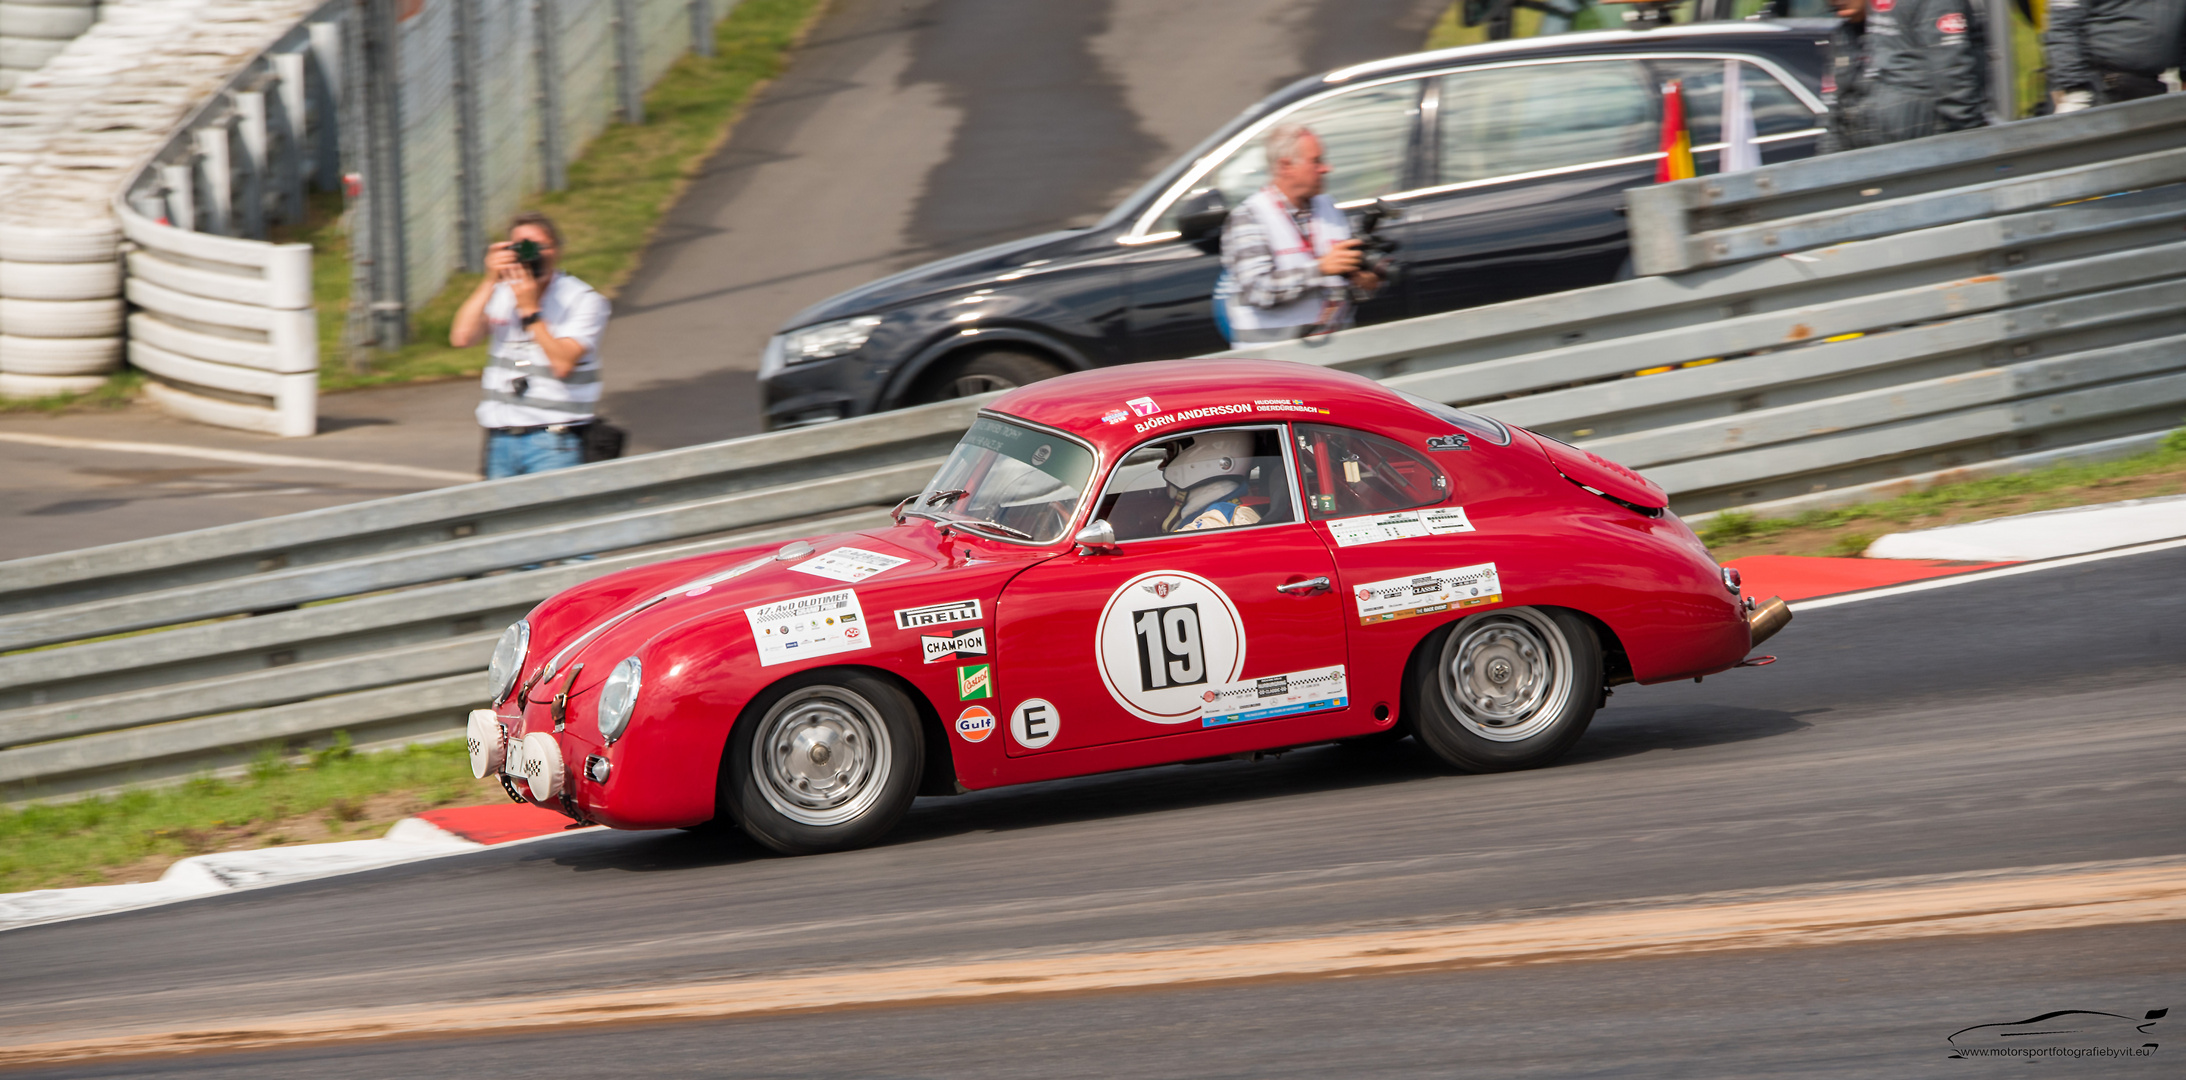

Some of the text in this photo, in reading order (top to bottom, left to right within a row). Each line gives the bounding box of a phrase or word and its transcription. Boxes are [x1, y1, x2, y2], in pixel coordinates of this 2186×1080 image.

[1134, 413, 1176, 433] BJÖRN
[1177, 403, 1252, 422] ANDERSSON
[757, 607, 774, 617] 47.
[775, 603, 795, 612] AvD
[797, 593, 848, 608] OLDTIMER
[900, 601, 977, 627] PIRELLI
[927, 637, 983, 653] CHAMPION
[1136, 606, 1204, 688] 19
[963, 670, 988, 693] Castrol
[960, 718, 991, 730] Gulf
[1023, 705, 1049, 740] E
